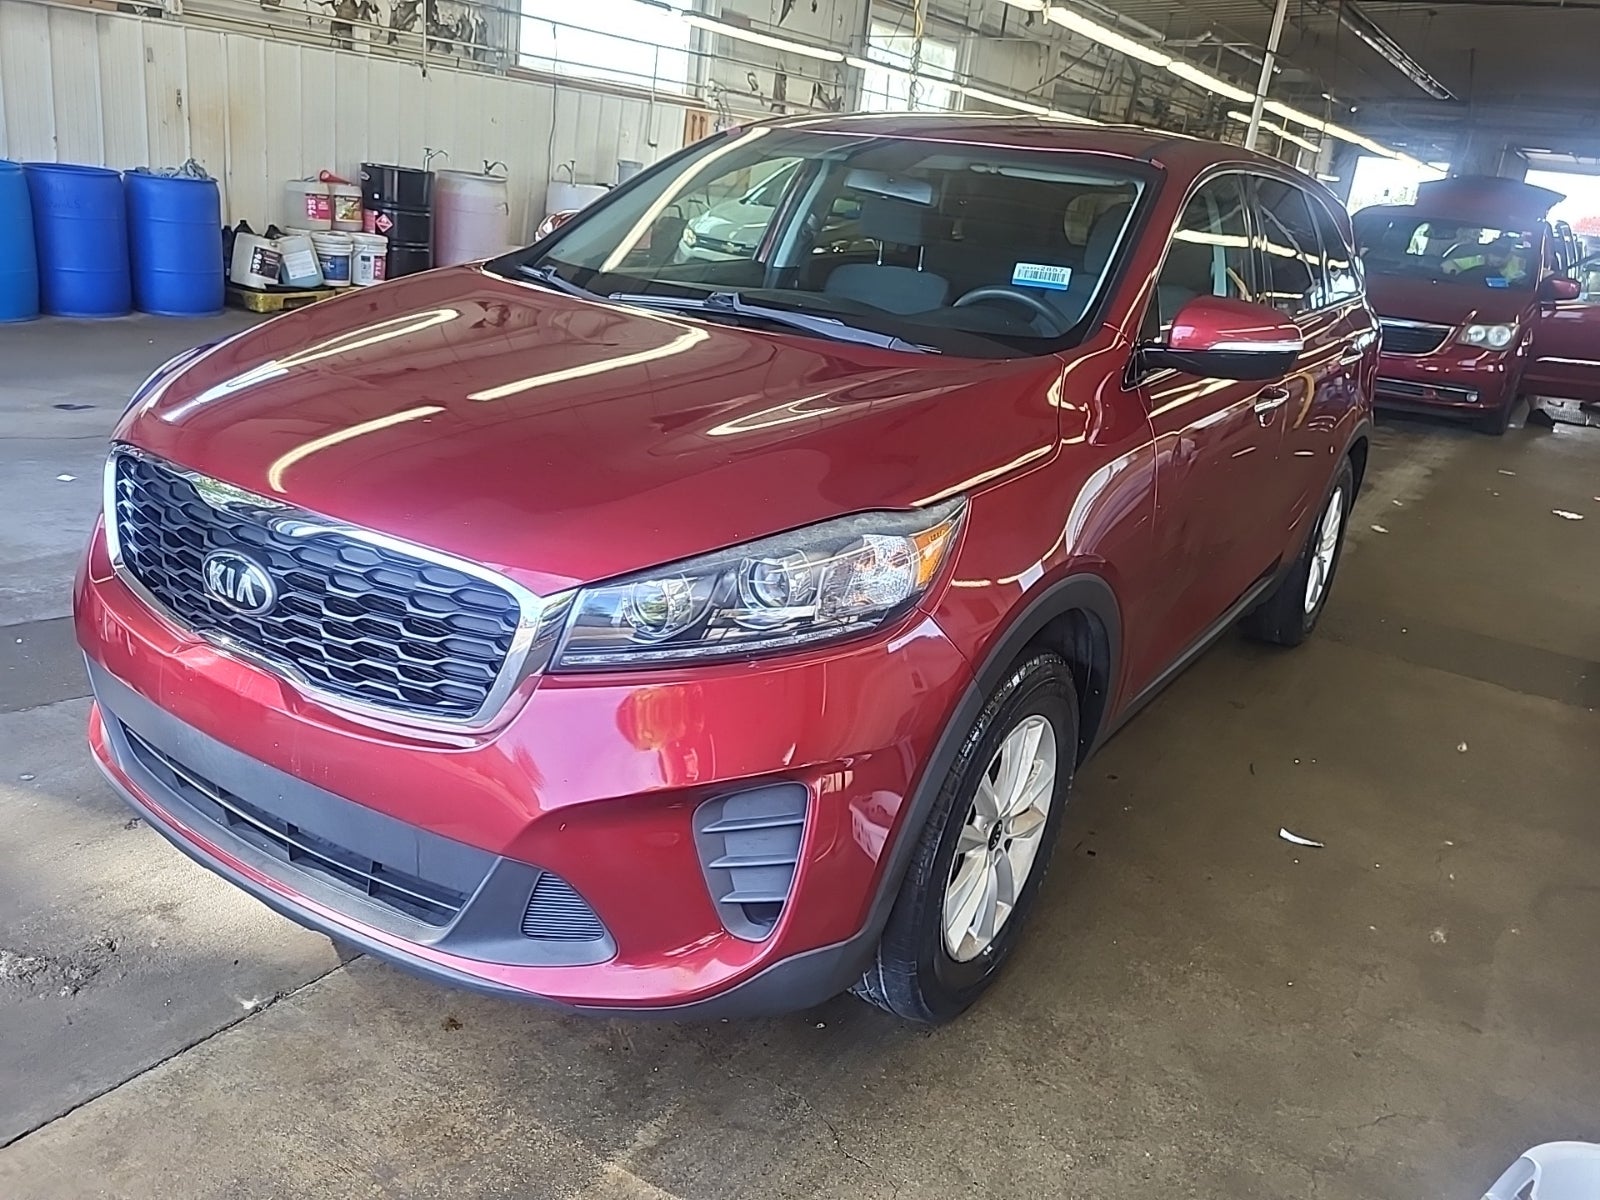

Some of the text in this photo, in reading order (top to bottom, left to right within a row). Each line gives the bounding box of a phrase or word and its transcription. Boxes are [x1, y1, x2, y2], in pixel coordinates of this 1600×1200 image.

[307, 199, 317, 216] 735
[252, 253, 263, 270] 596
[210, 560, 257, 607] KIA
